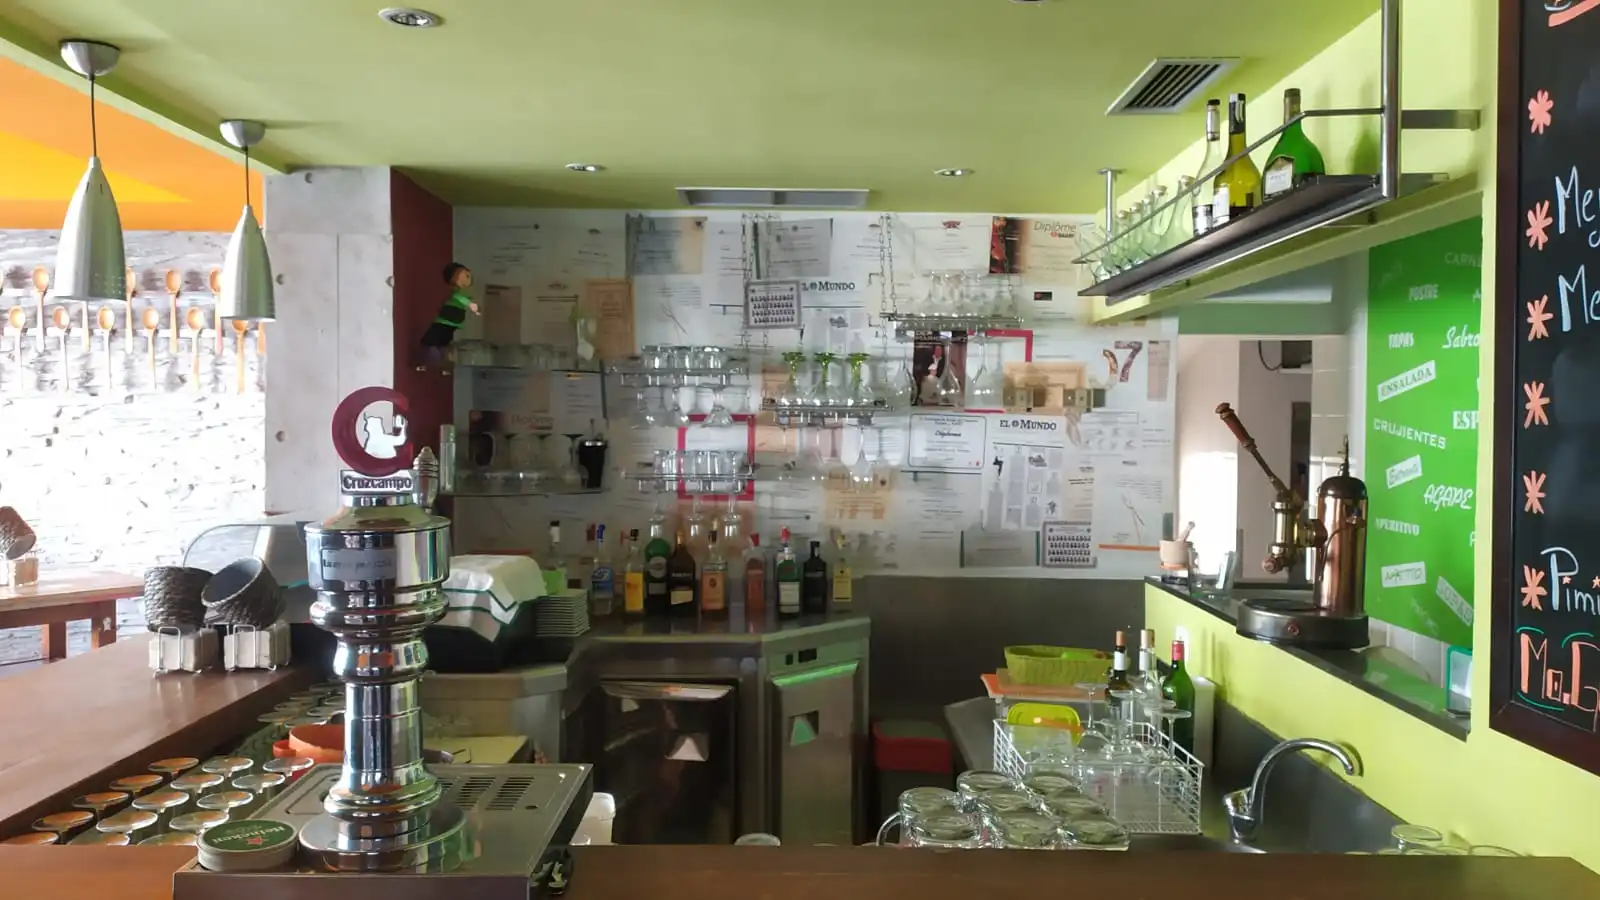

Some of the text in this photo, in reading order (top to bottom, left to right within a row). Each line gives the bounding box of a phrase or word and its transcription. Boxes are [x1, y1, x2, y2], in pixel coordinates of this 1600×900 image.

[1020, 419, 1057, 430] MUNDO
[1374, 418, 1446, 449] CRUJIENTES
[343, 476, 413, 490] Cruzcampo
[1424, 484, 1473, 511] AGAPE
